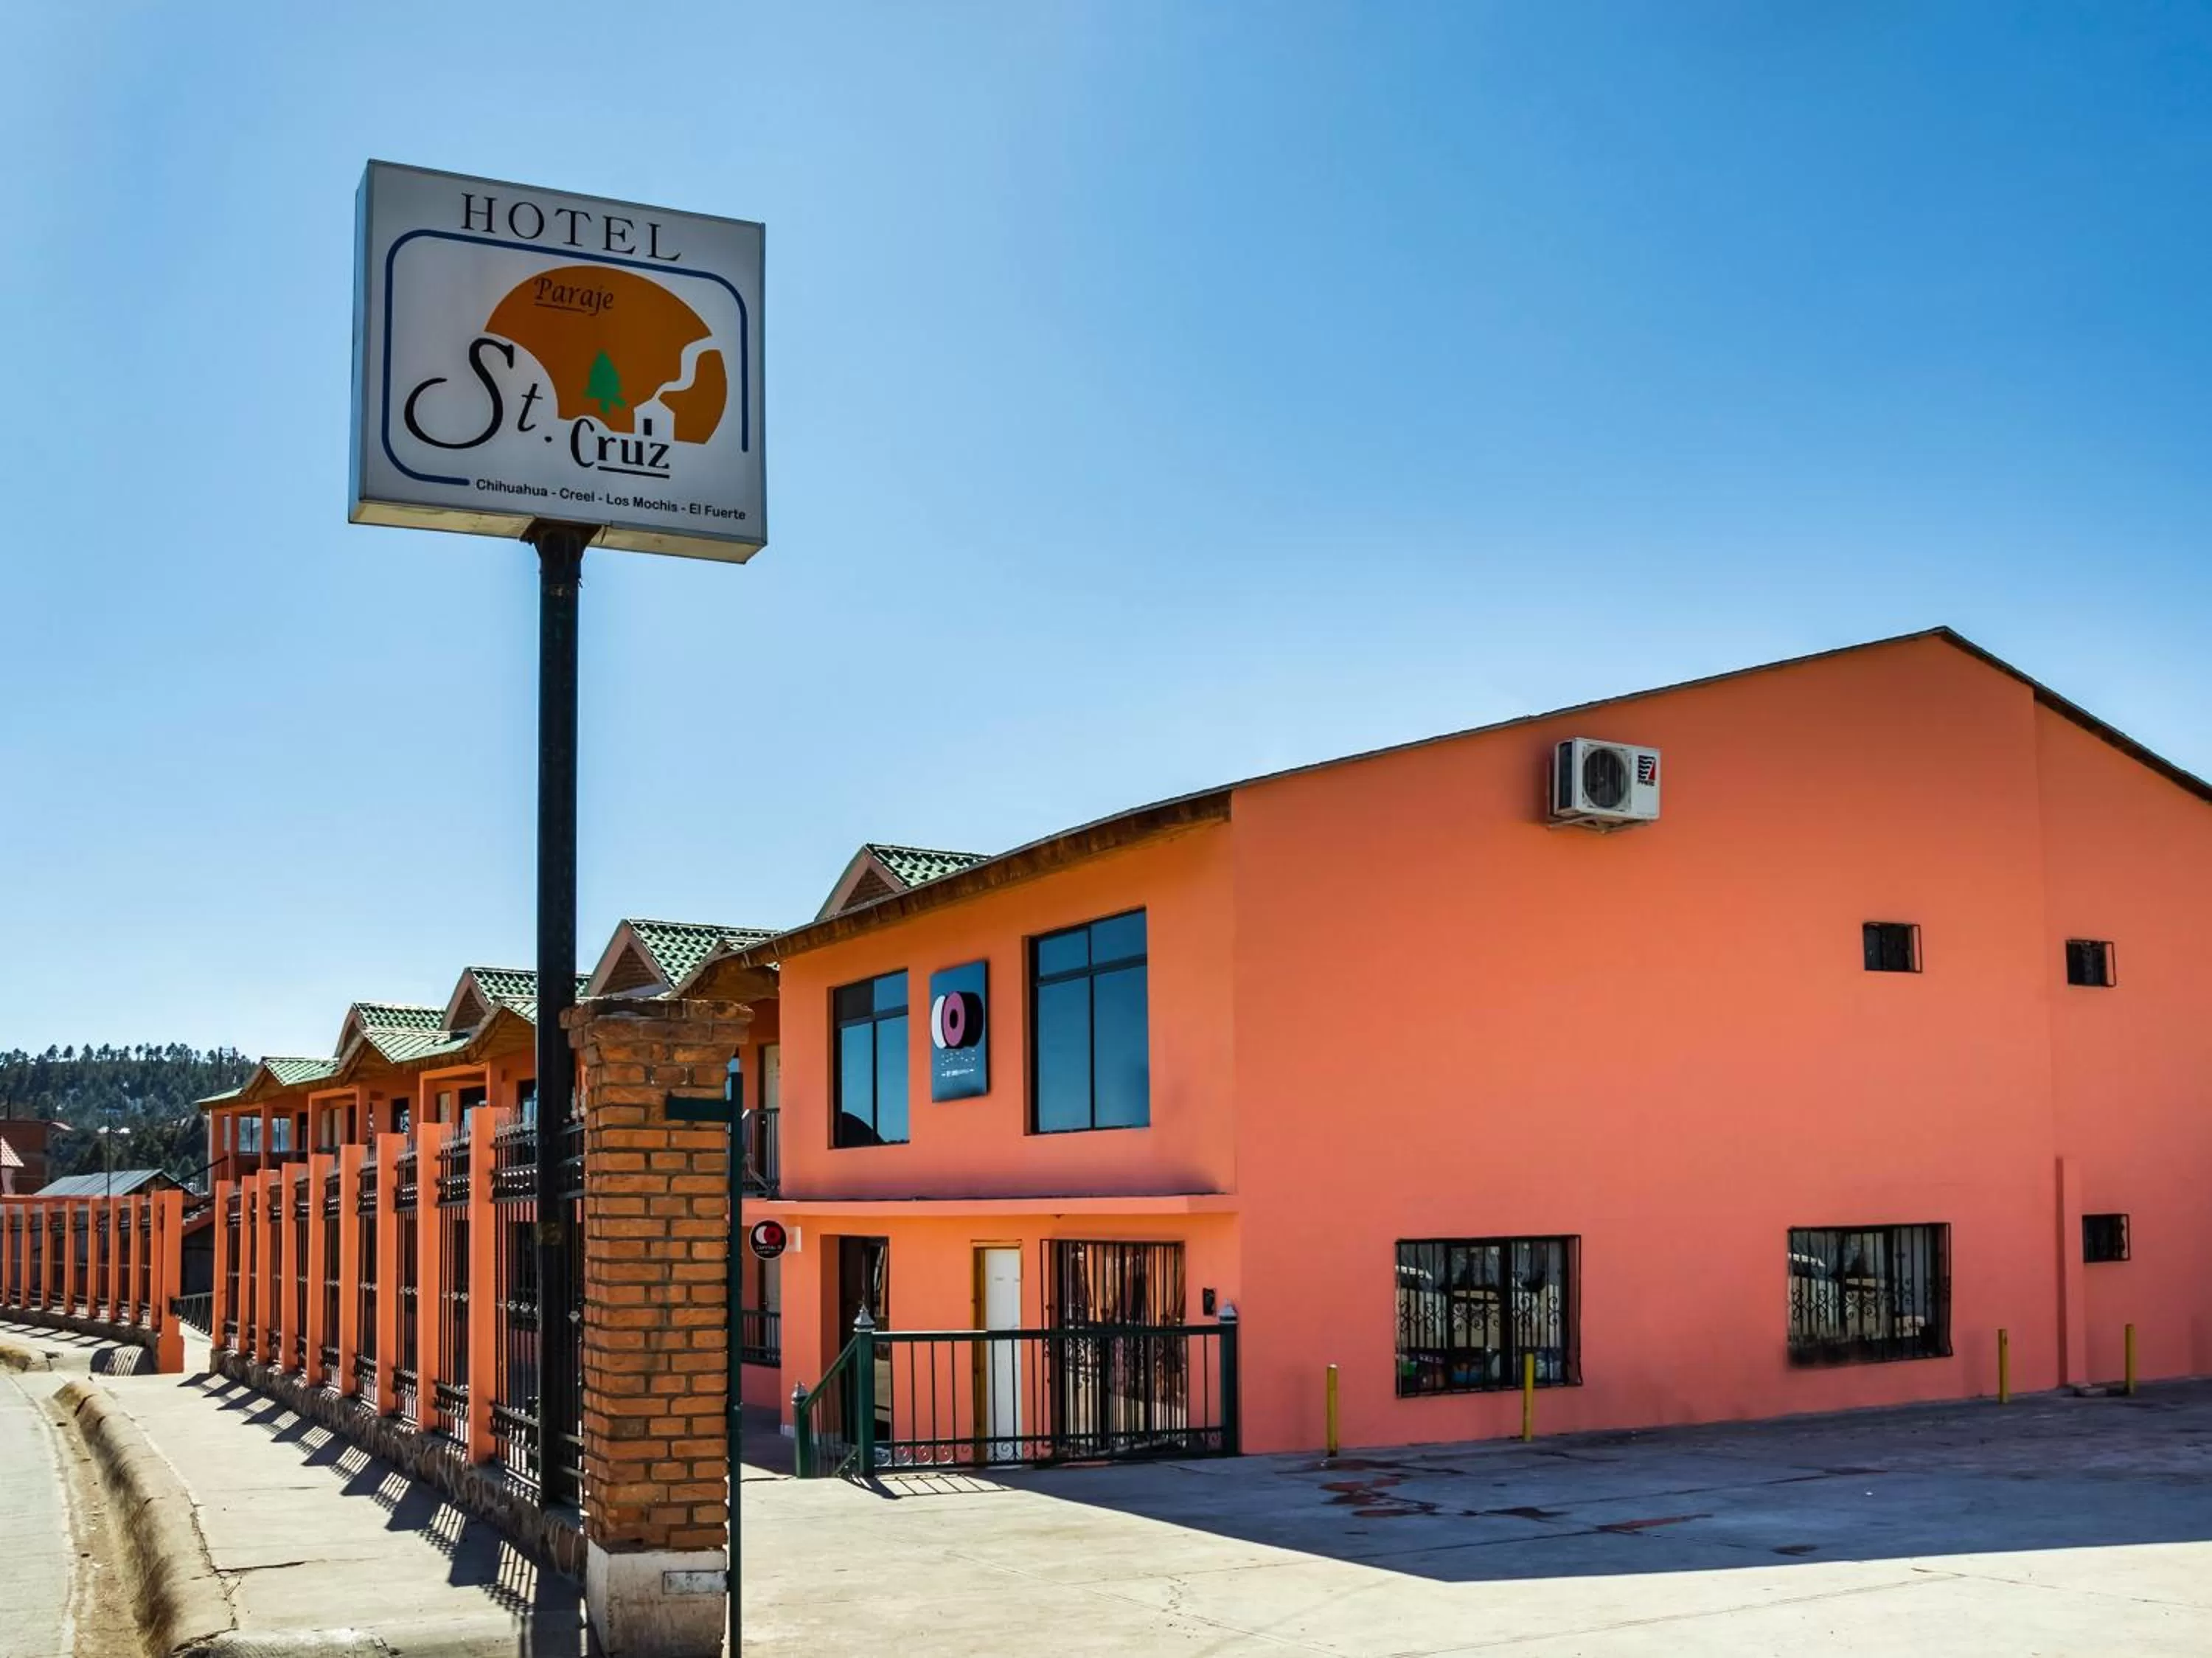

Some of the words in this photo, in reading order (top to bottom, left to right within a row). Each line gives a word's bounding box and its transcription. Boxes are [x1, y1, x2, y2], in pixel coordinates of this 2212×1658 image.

[461, 192, 681, 262] HOTEL
[534, 277, 614, 316] Paraje
[403, 337, 553, 449] St.
[570, 418, 669, 471] Cruz
[477, 479, 548, 496] Chihuahua
[560, 488, 594, 503] Creel
[606, 493, 629, 507] Los
[633, 497, 677, 513] Mochis
[689, 503, 702, 514] El
[705, 505, 746, 521] Fuerte
